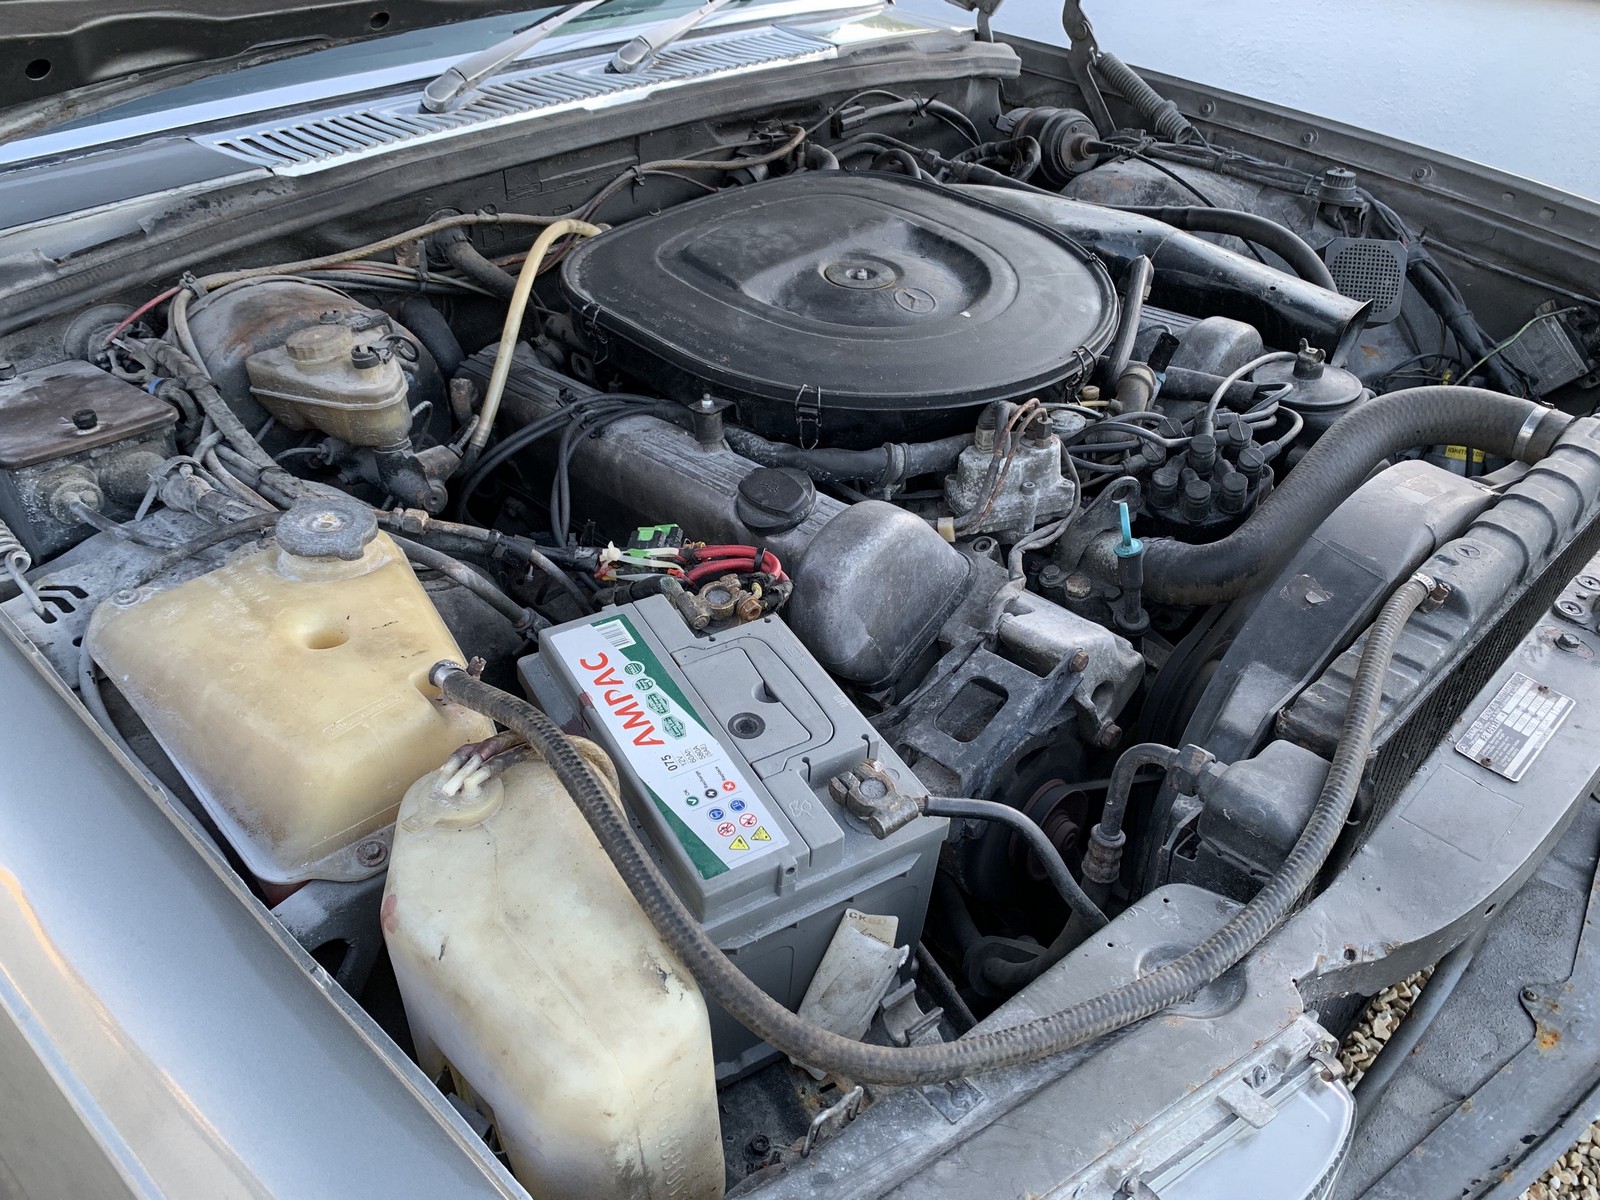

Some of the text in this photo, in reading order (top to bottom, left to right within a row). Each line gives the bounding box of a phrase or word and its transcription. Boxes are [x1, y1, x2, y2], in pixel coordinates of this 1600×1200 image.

[579, 652, 665, 746] AMPAC
[661, 754, 678, 772] 075
[675, 756, 687, 767] 12V
[684, 749, 697, 764] 60Ah
